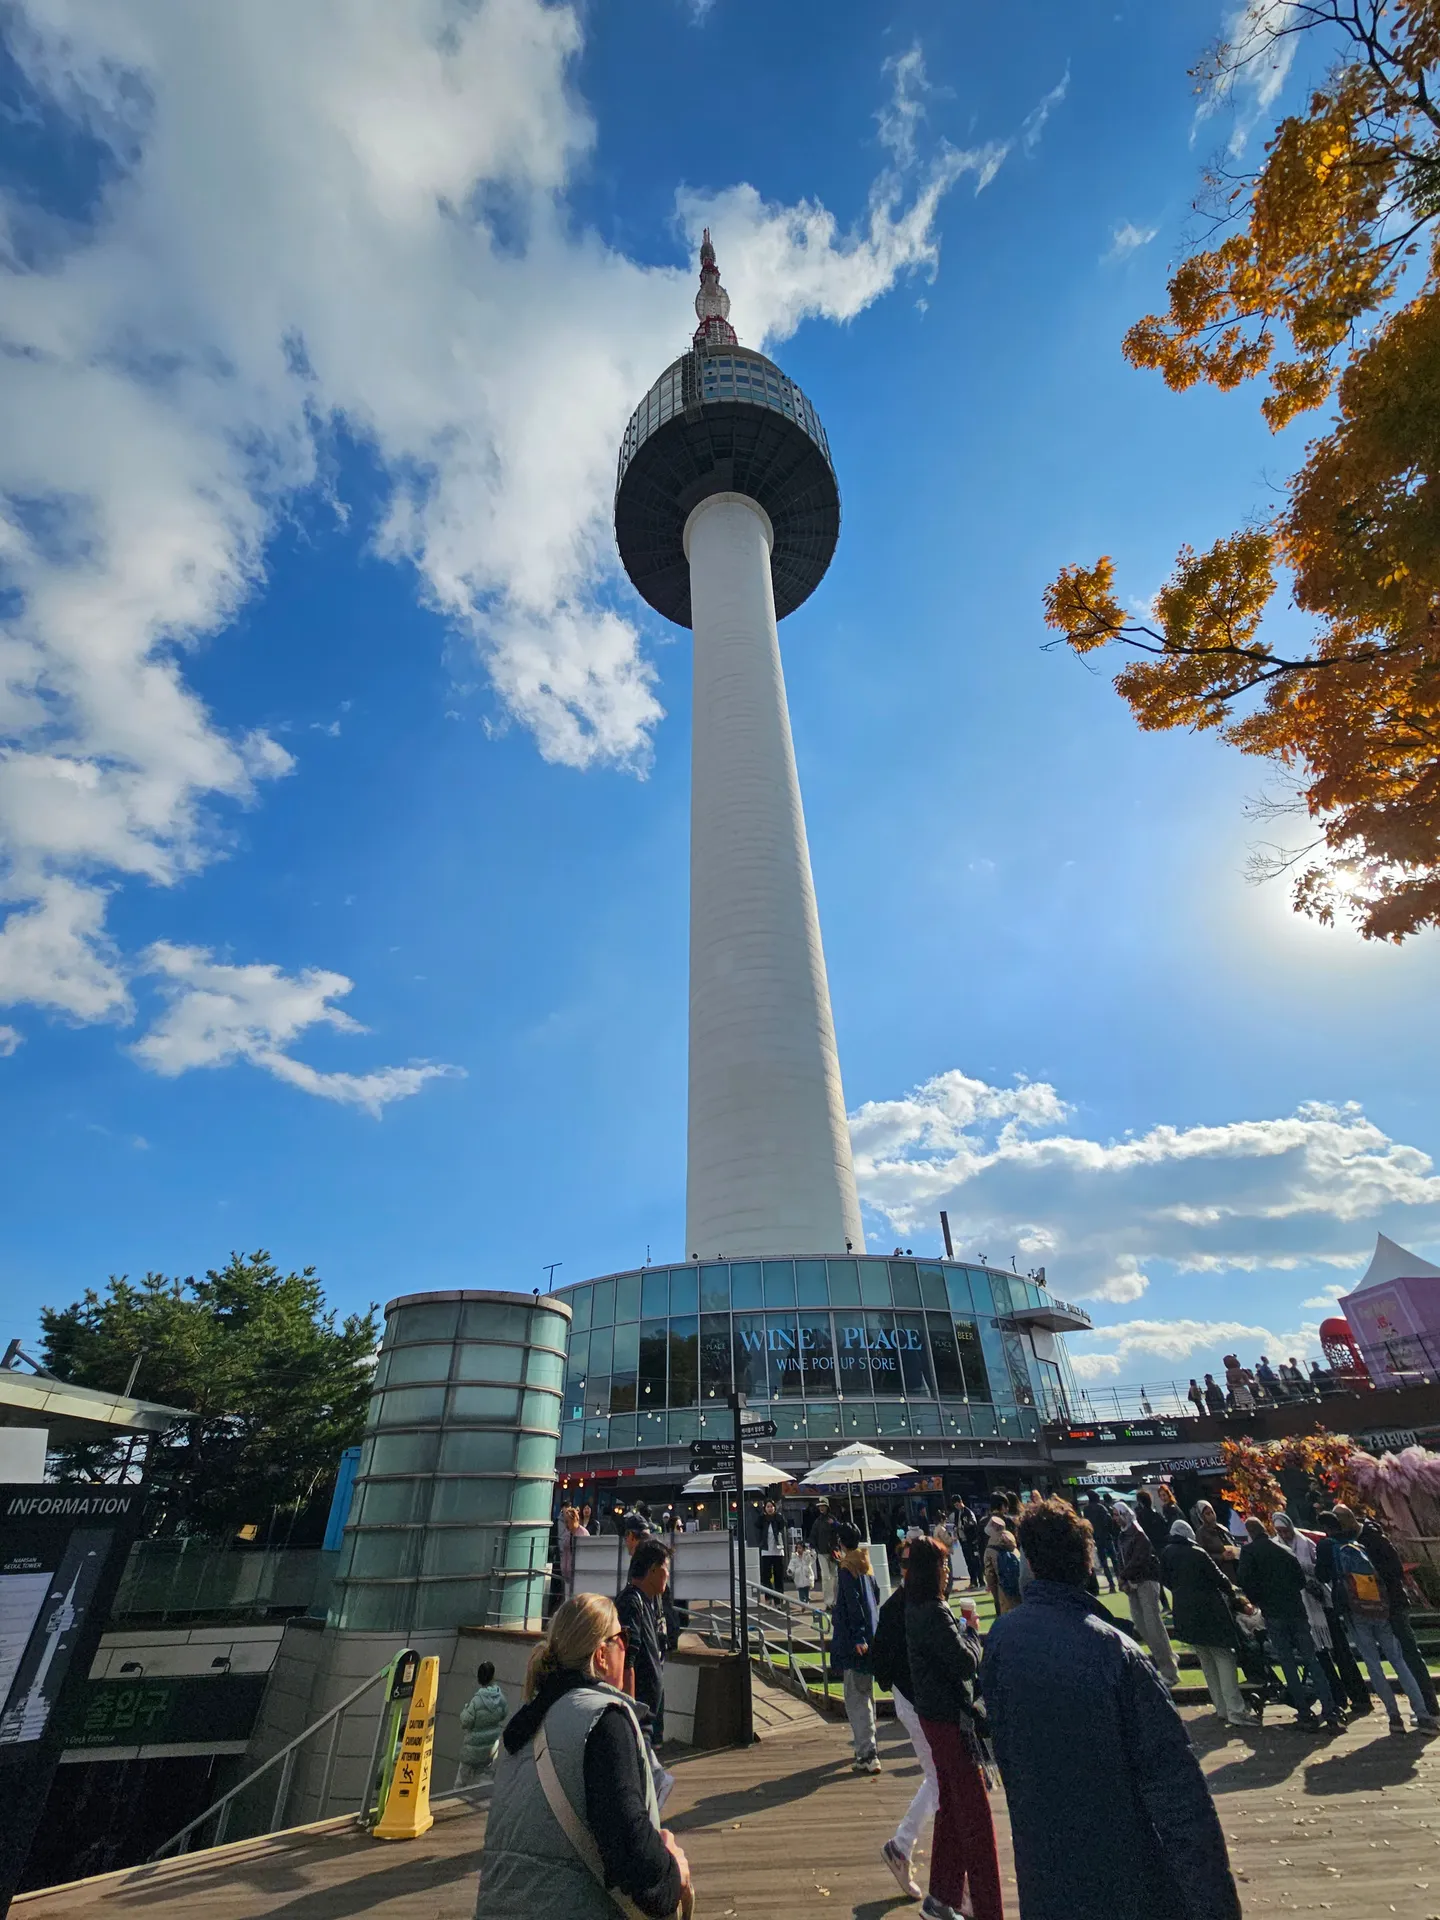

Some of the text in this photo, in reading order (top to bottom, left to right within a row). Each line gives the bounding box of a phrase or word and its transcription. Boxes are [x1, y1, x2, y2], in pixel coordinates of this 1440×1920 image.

[954, 1319, 972, 1329] WINE
[739, 1328, 816, 1352] WINE
[842, 1327, 922, 1351] PLACE
[957, 1331, 975, 1341] BEER
[776, 1357, 809, 1371] WINE
[840, 1357, 855, 1371] UP
[1200, 1455, 1226, 1467] PLACE
[1077, 1476, 1117, 1485] TERRACE
[828, 1482, 898, 1493] N GFT SHOP
[7, 1498, 131, 1515] INFORMATION
[84, 1689, 170, 1730] 출입구
[409, 1720, 424, 1729] CAUTION
